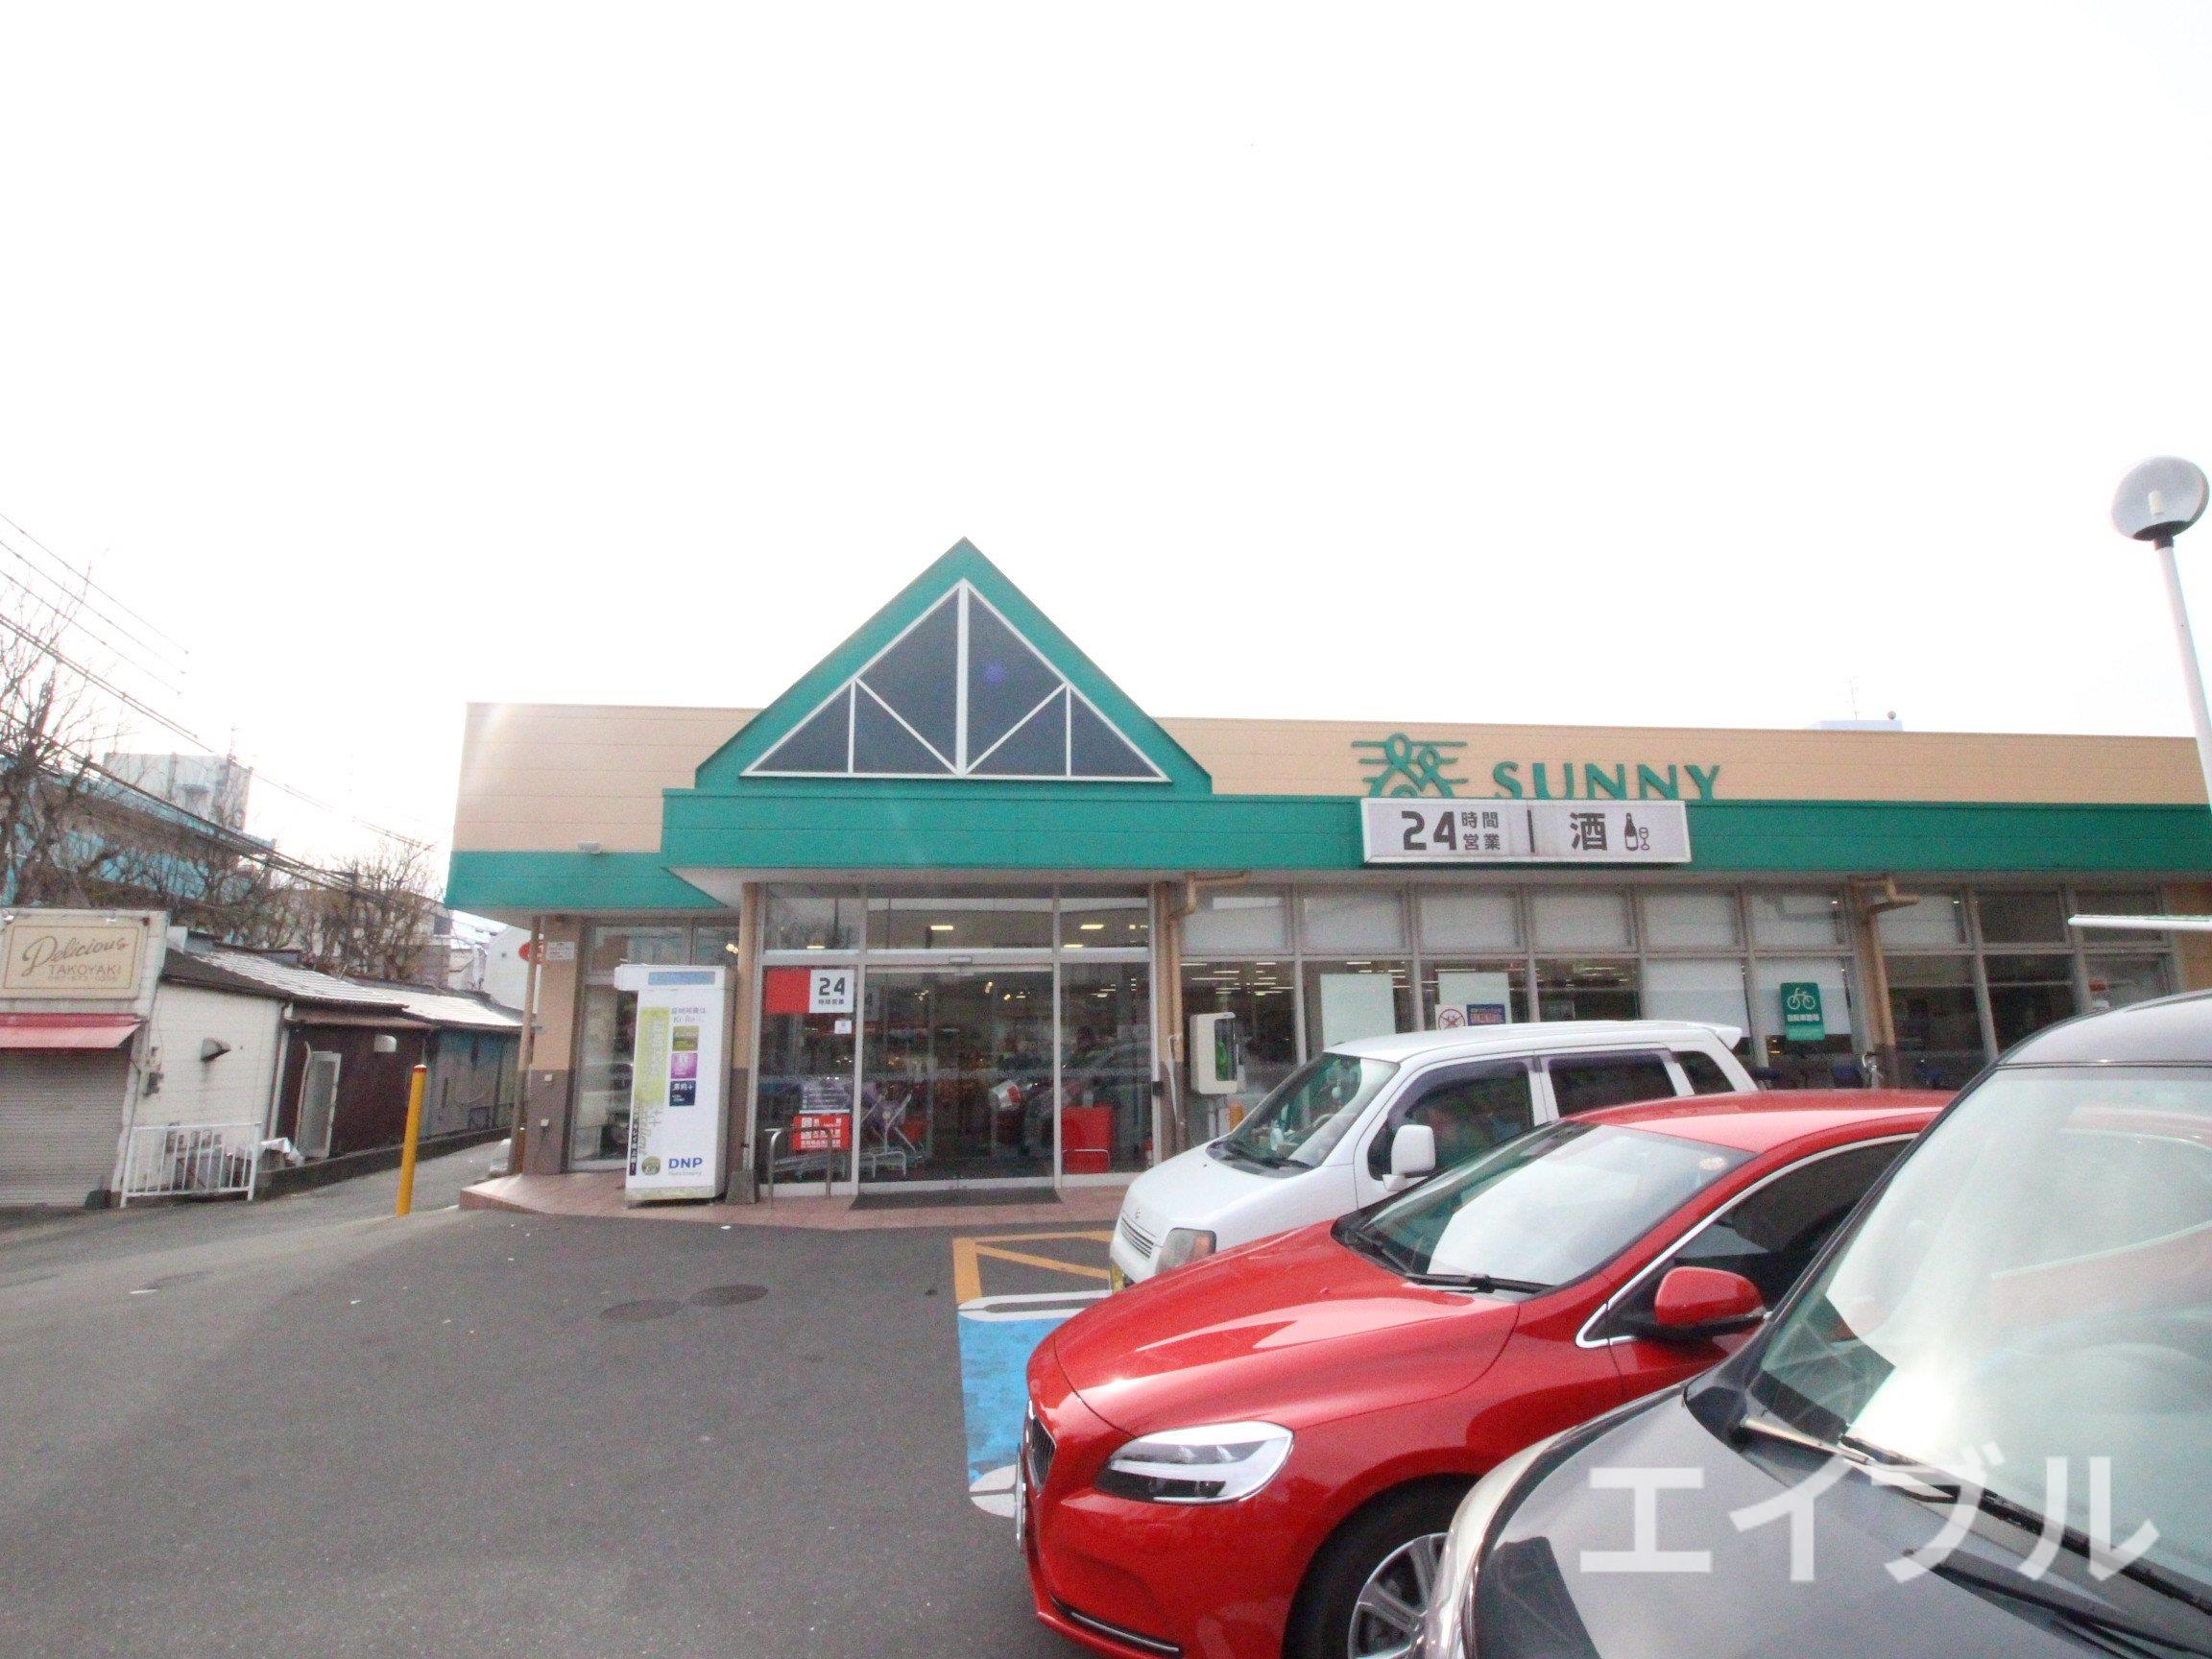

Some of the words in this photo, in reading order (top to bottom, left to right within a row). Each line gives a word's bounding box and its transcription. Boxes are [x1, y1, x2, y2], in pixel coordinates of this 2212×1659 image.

[1493, 761, 1720, 801] SUNNY
[1401, 810, 1457, 851] 24
[1461, 811, 1500, 830] 時間
[1569, 812, 1608, 851] 酒
[1463, 833, 1501, 851] 営業
[21, 935, 129, 977] Delicious
[49, 963, 122, 975] TAKOYAKI
[819, 976, 846, 996] 24
[669, 1157, 703, 1168] DNP
